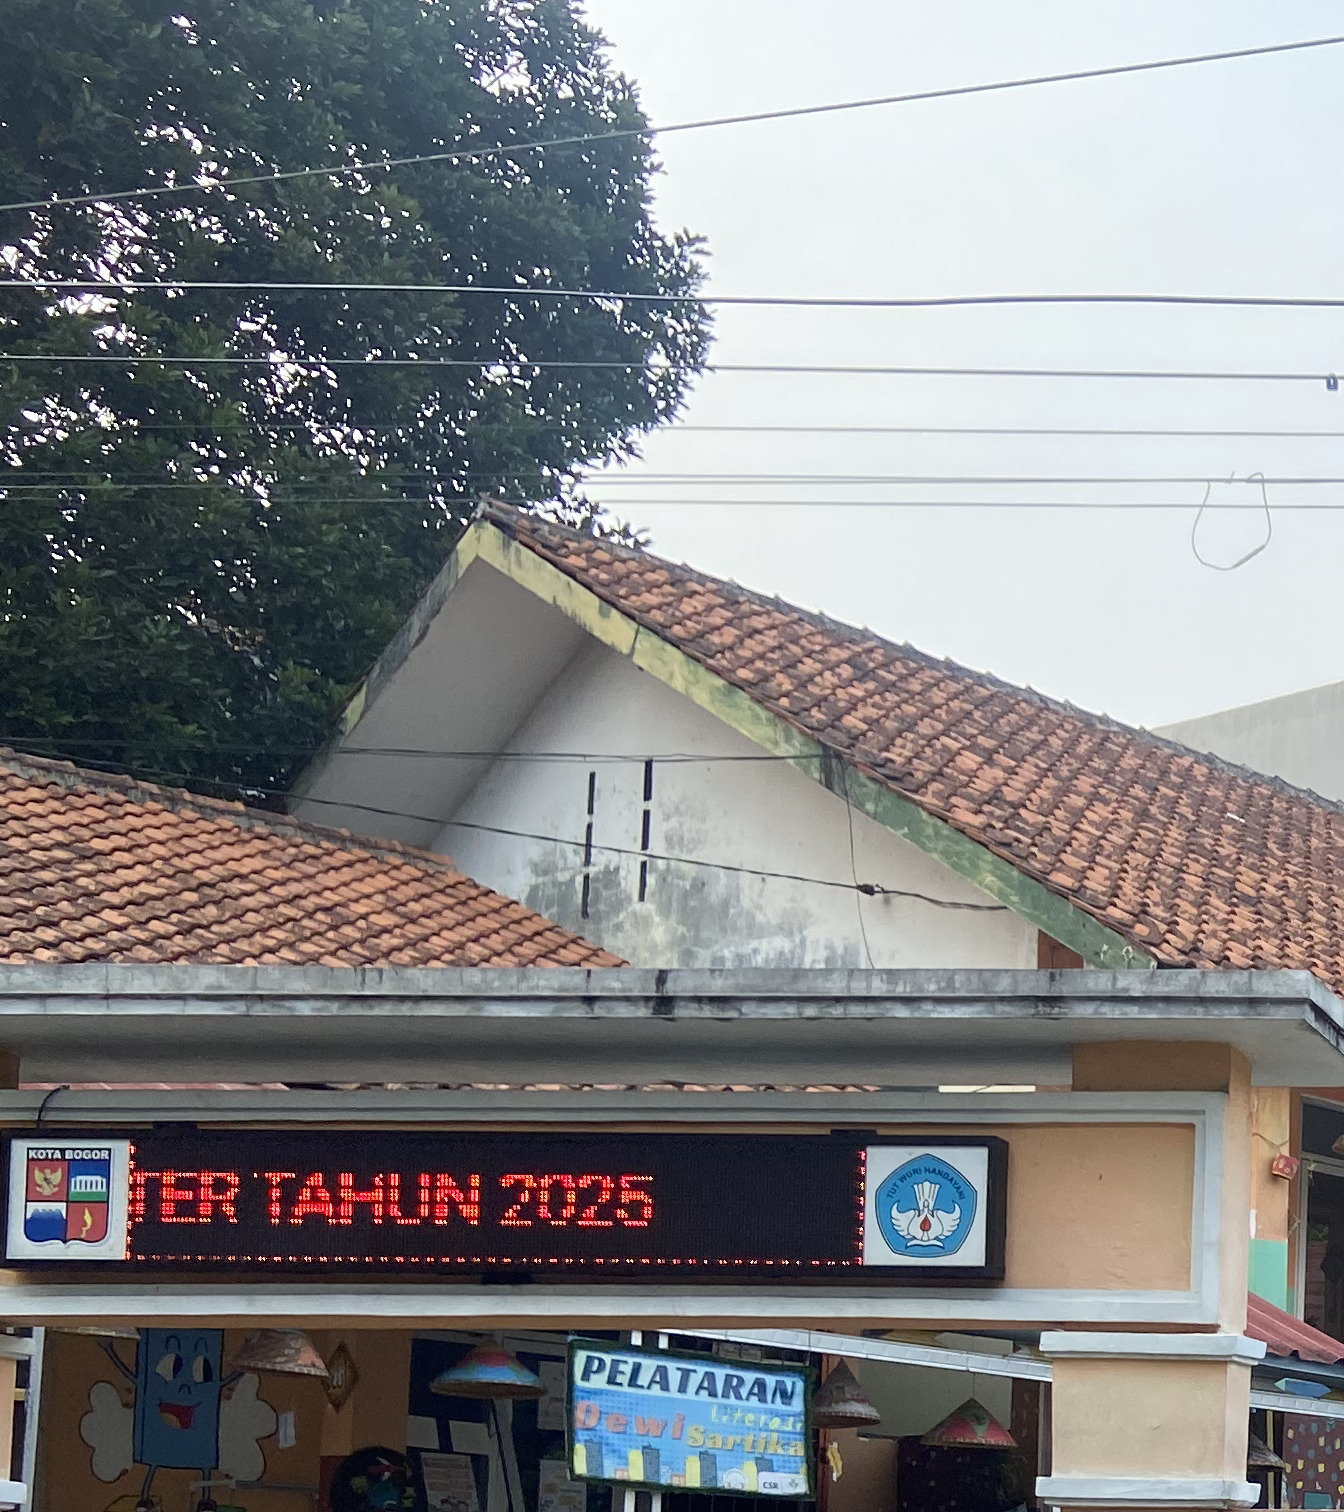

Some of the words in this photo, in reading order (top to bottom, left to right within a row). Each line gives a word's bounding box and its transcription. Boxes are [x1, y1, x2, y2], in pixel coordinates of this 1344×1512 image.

[29, 1149, 61, 1159] KOTA
[65, 1149, 109, 1160] BOGOR
[253, 1171, 481, 1227] TAHUN
[499, 1173, 656, 1228] 2025
[886, 1183, 900, 1198] TUT
[899, 1166, 922, 1184] WURI
[924, 1166, 966, 1201] HANDAYANI
[580, 1355, 796, 1406] PELATARAN
[686, 1425, 805, 1456] Sartika
[762, 1481, 779, 1490] CSR
